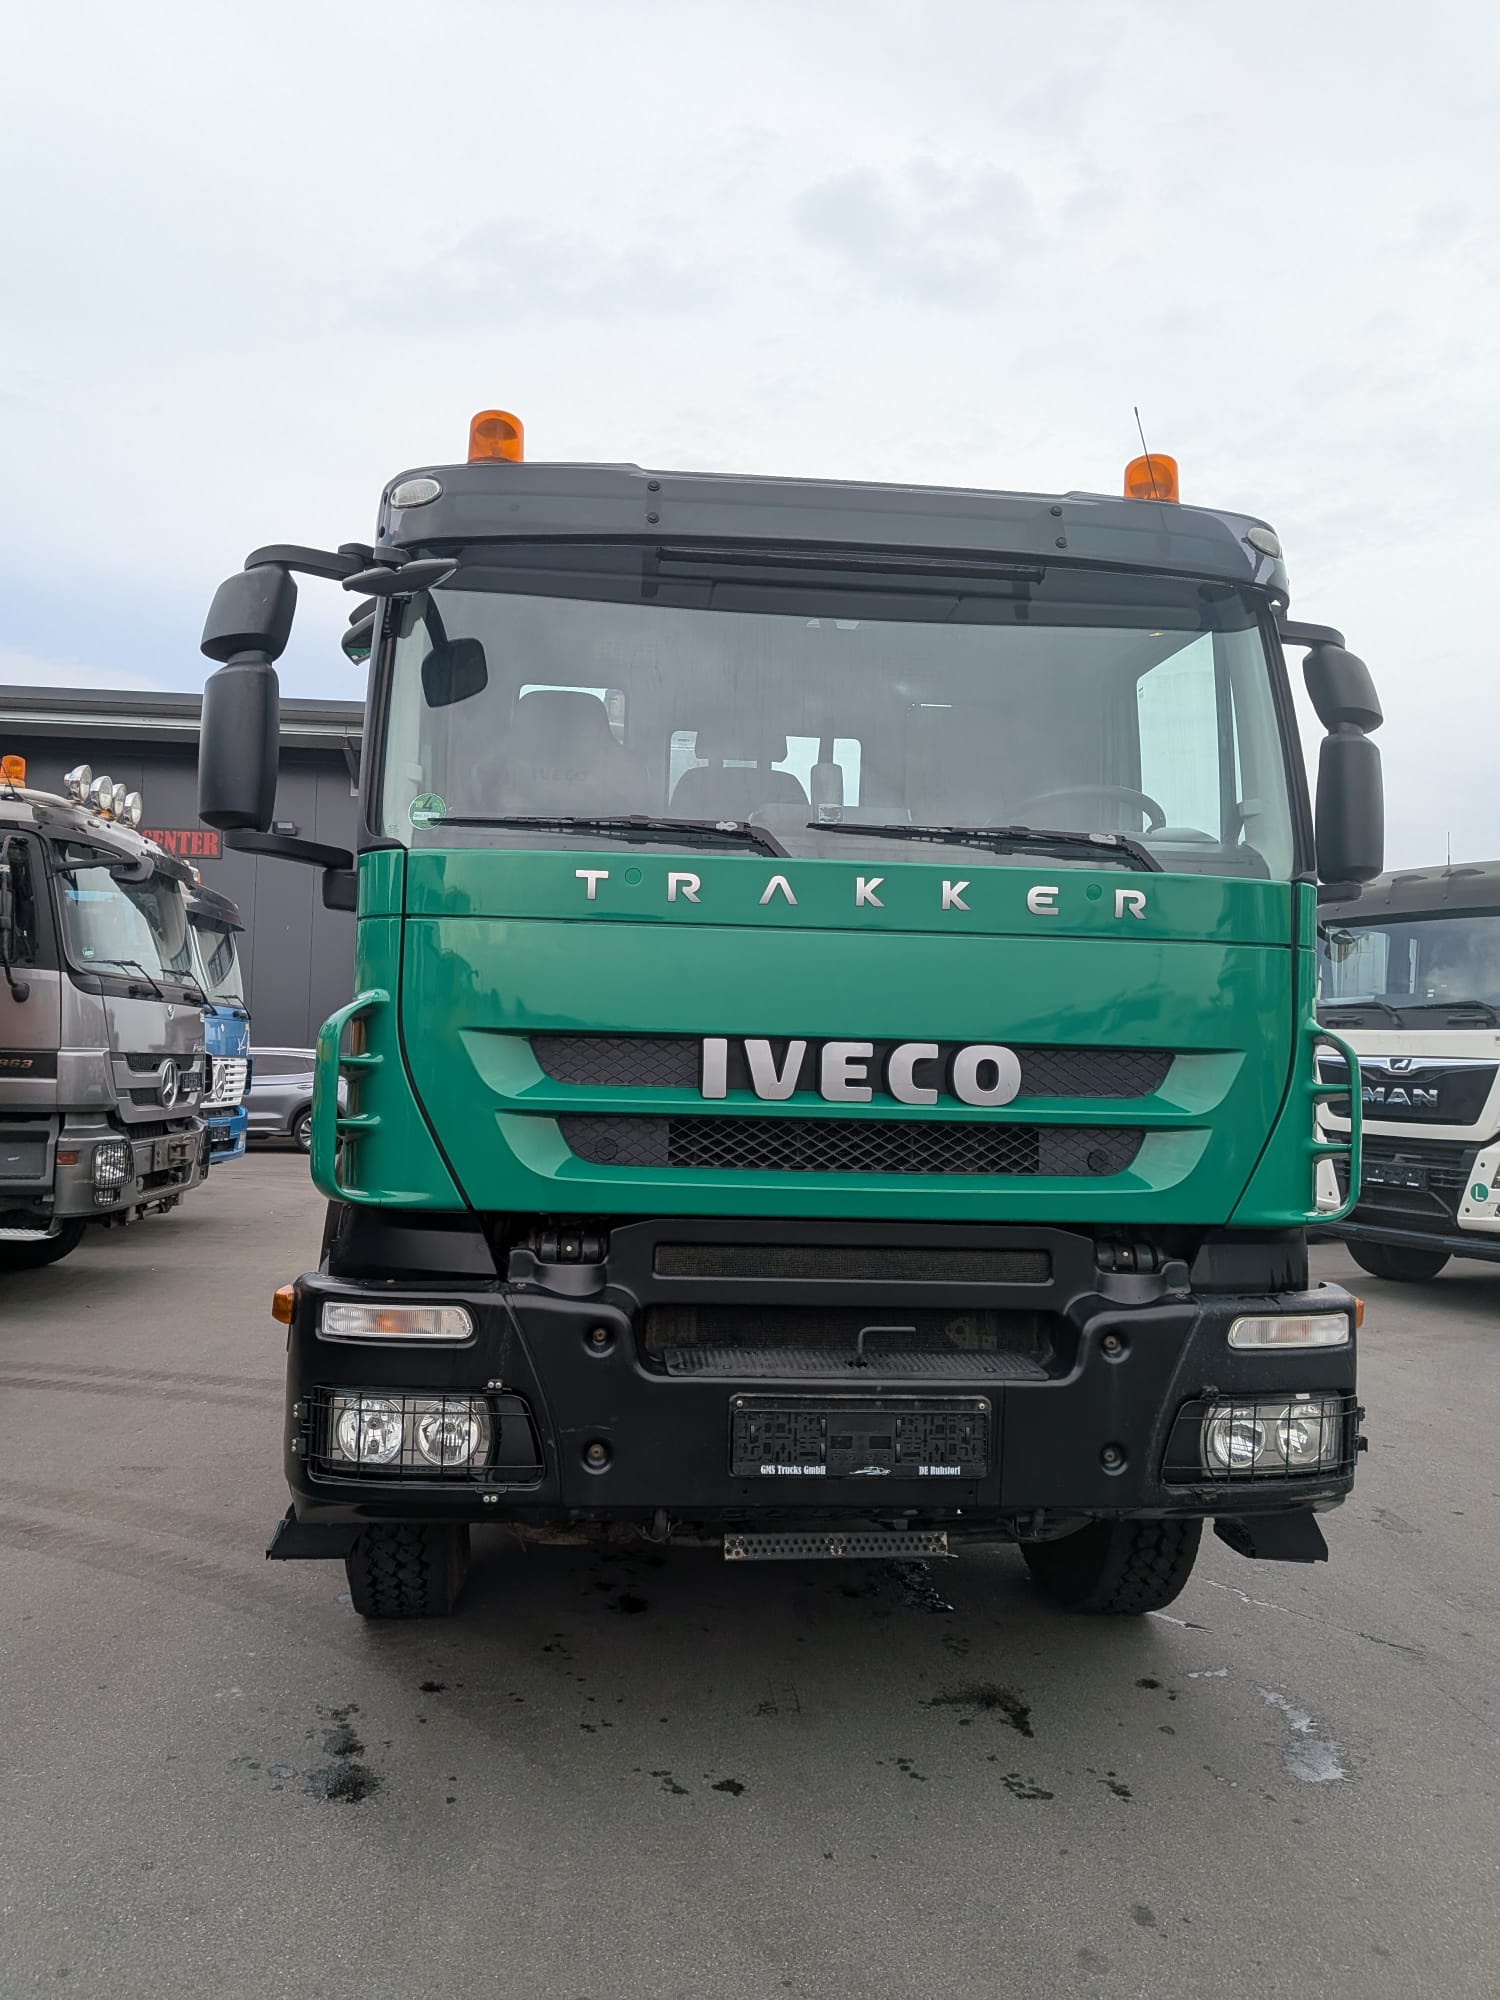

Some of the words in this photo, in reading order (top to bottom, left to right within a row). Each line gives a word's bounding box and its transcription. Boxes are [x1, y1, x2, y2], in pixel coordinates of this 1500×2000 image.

[422, 795, 433, 812] 4
[575, 868, 1148, 921] TRAKKER
[702, 1037, 1023, 1107] IVECO
[1361, 1085, 1439, 1108] MAN
[760, 1464, 776, 1475] GMS
[777, 1464, 802, 1475] Trucks
[803, 1465, 827, 1475] GmbH
[919, 1465, 929, 1476] DE
